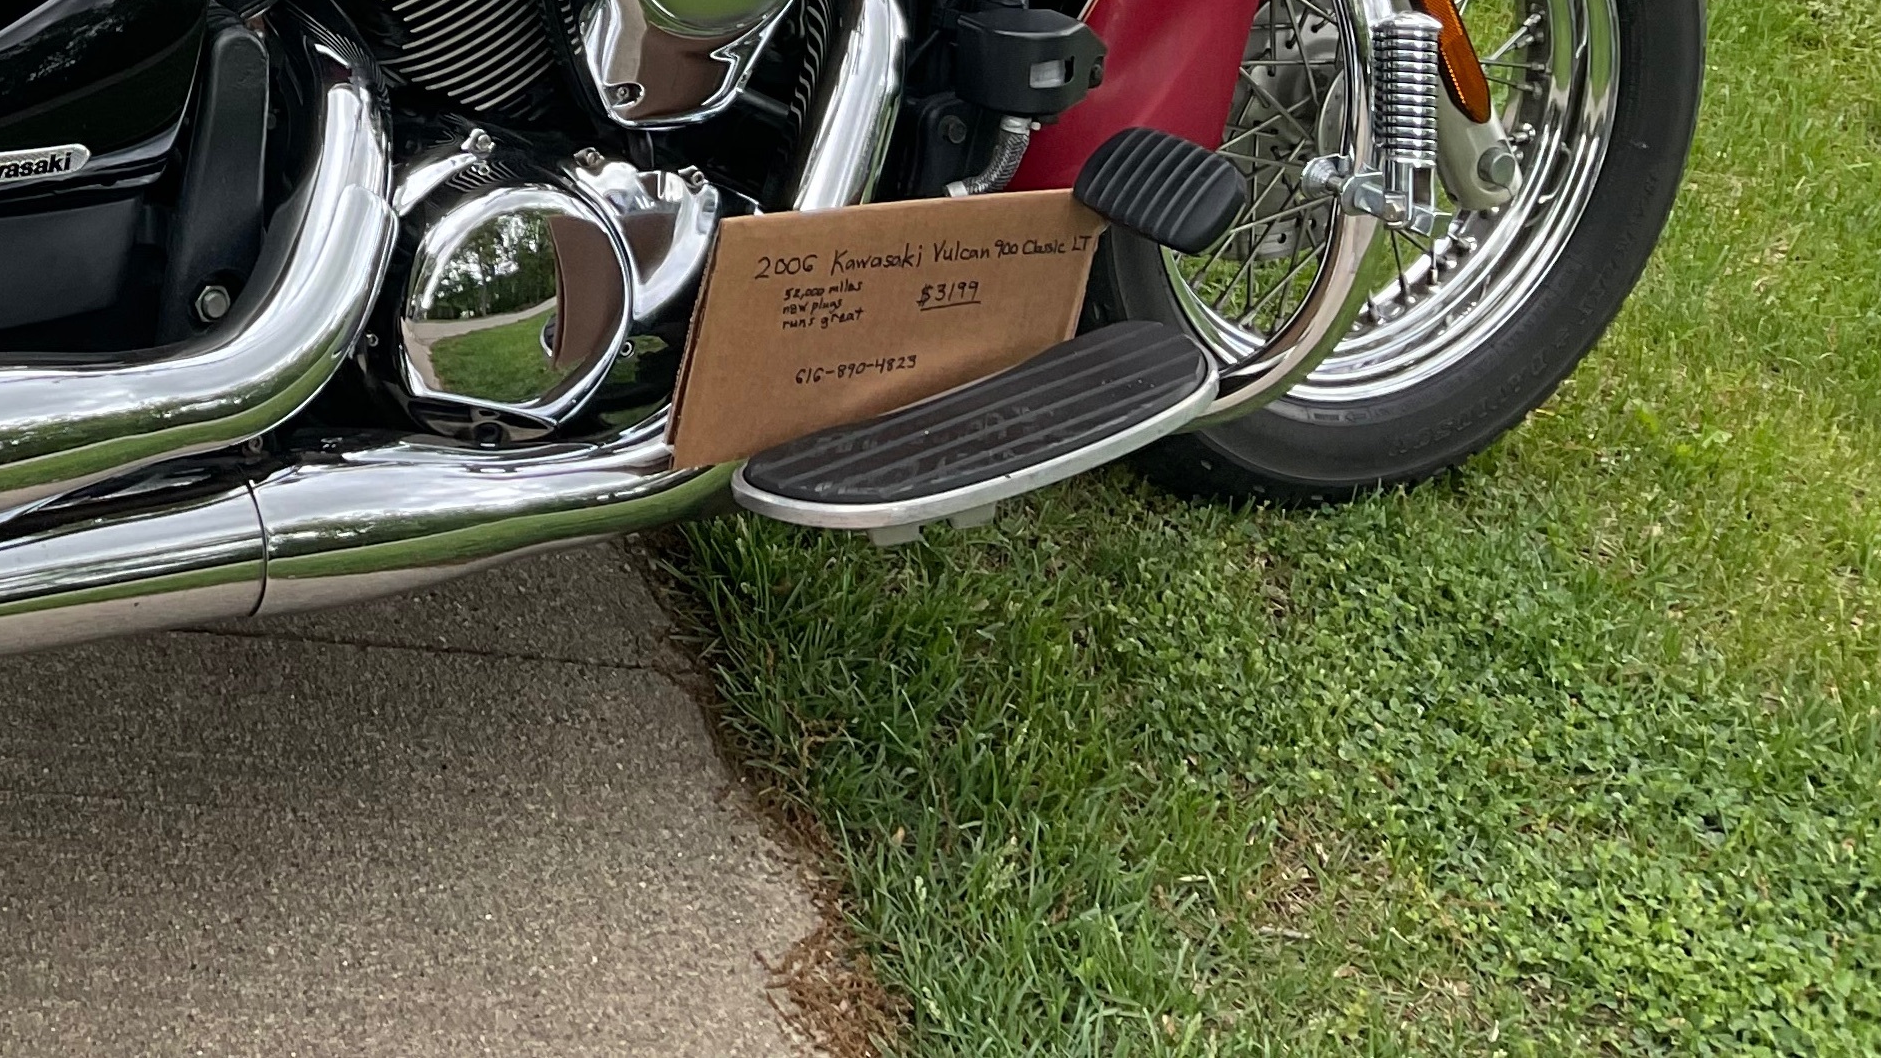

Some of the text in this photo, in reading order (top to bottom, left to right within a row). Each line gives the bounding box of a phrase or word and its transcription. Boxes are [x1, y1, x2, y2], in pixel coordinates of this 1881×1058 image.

[755, 235, 1092, 279] 2006 Kawasaki Vulcan 900 Classic LT
[783, 297, 843, 315] new plugs
[916, 280, 980, 307] $3199
[782, 307, 864, 330] runs great
[795, 354, 917, 384] 616-890-4823
